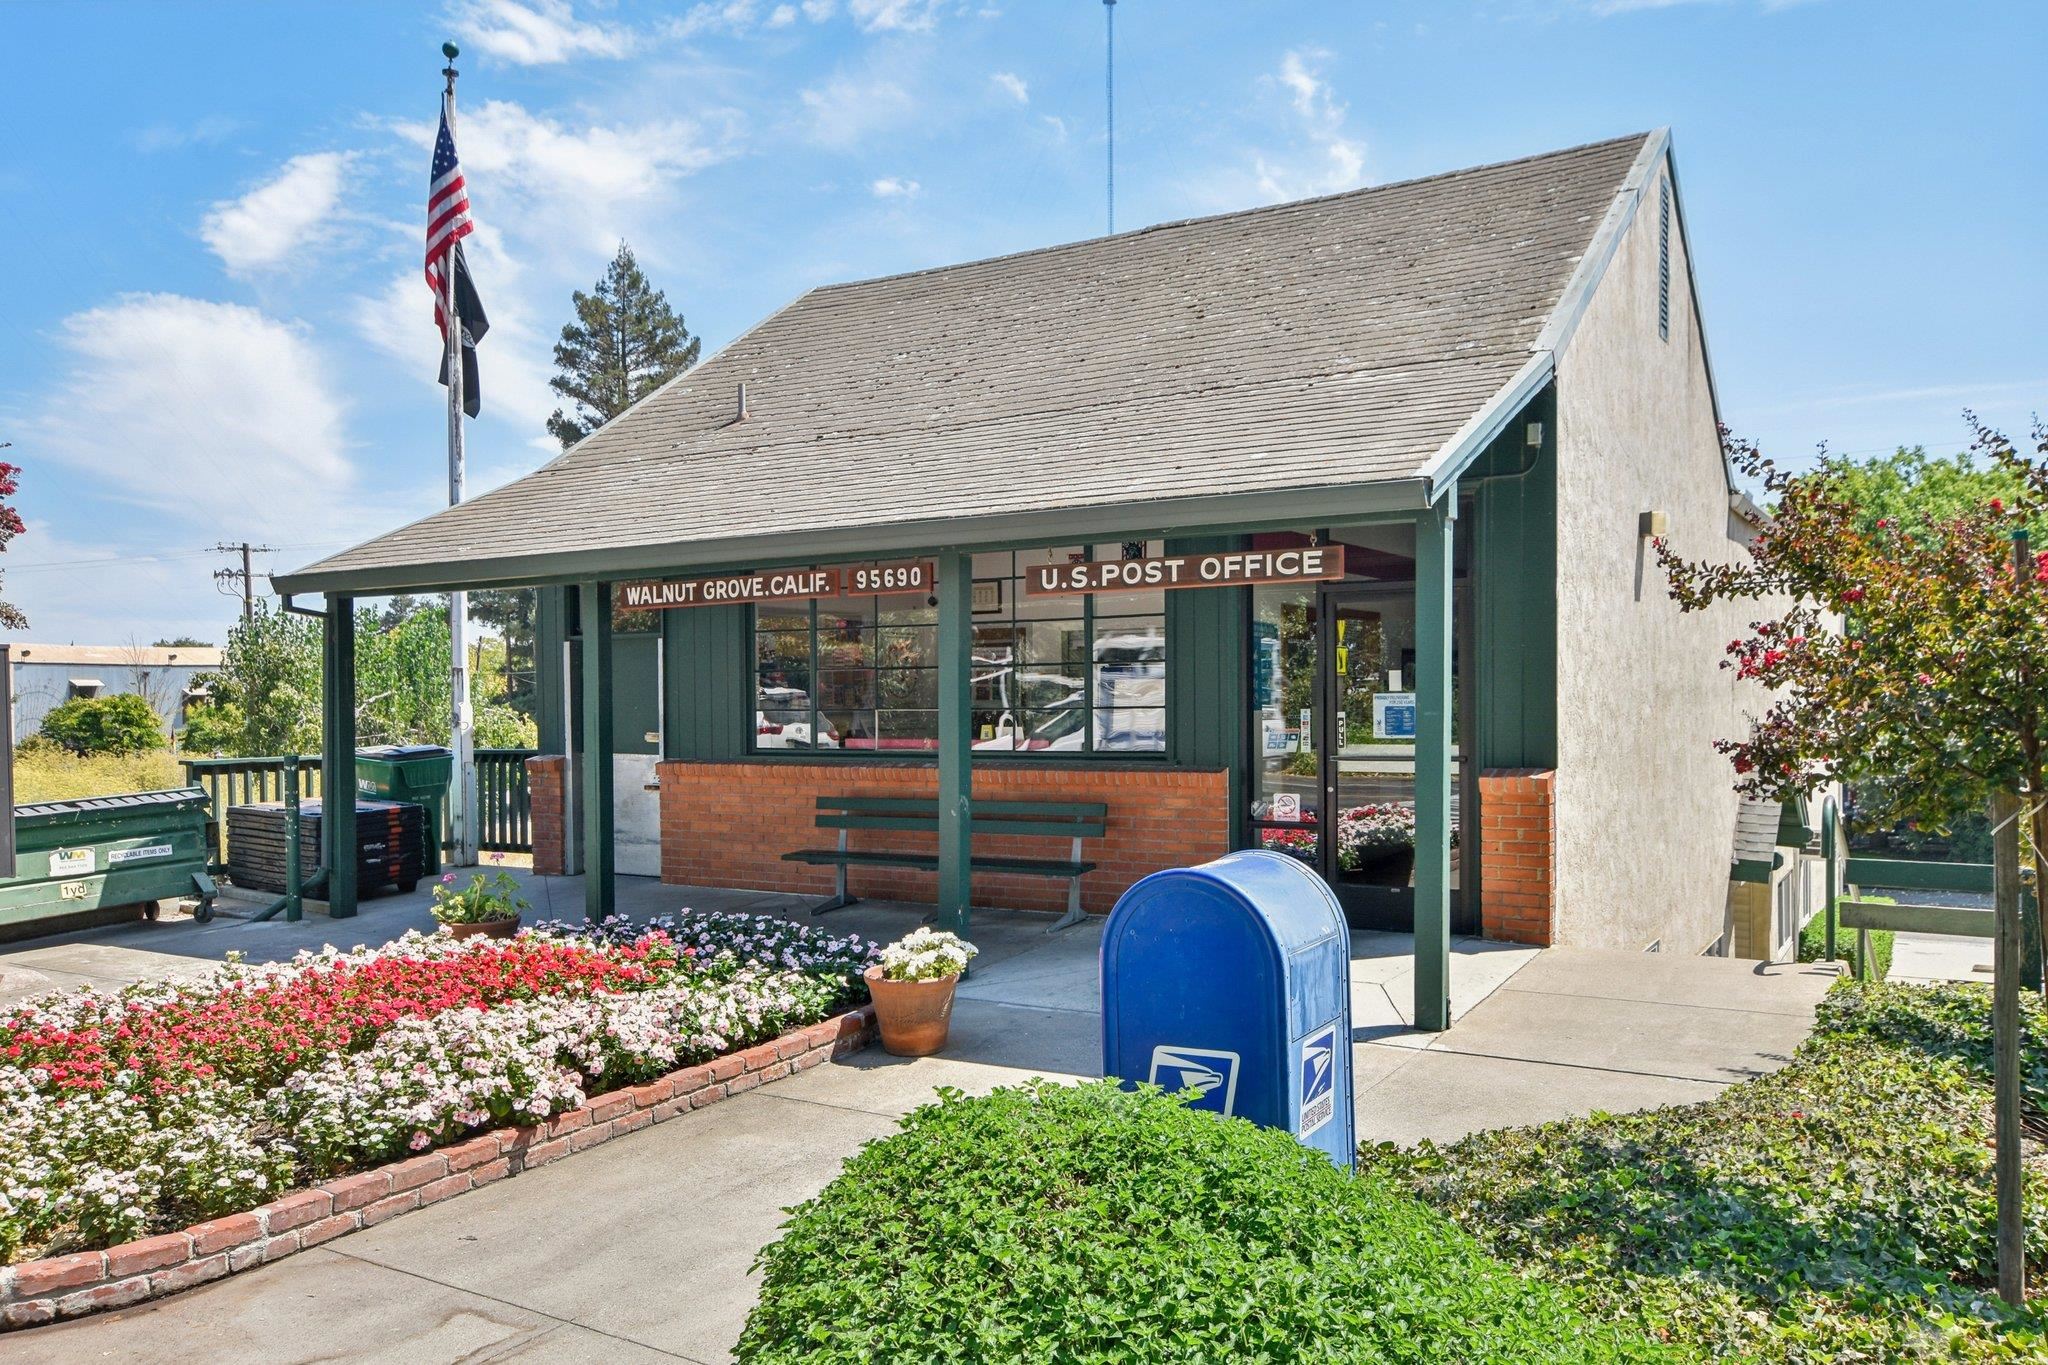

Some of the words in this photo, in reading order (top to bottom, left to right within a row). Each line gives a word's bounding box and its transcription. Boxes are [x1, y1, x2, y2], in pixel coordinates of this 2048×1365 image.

[1200, 550, 1323, 580] OFFICE
[856, 567, 922, 589] 95690
[626, 582, 697, 605] WALNUT
[59, 852, 86, 860] WM
[110, 850, 142, 860] RECYCLABLE
[63, 885, 85, 895] 1yd
[1301, 1105, 1317, 1121] UNITED
[1317, 1096, 1330, 1111] STATES
[1301, 1114, 1316, 1132] POSTAL
[1316, 1106, 1332, 1123] SERVICE
